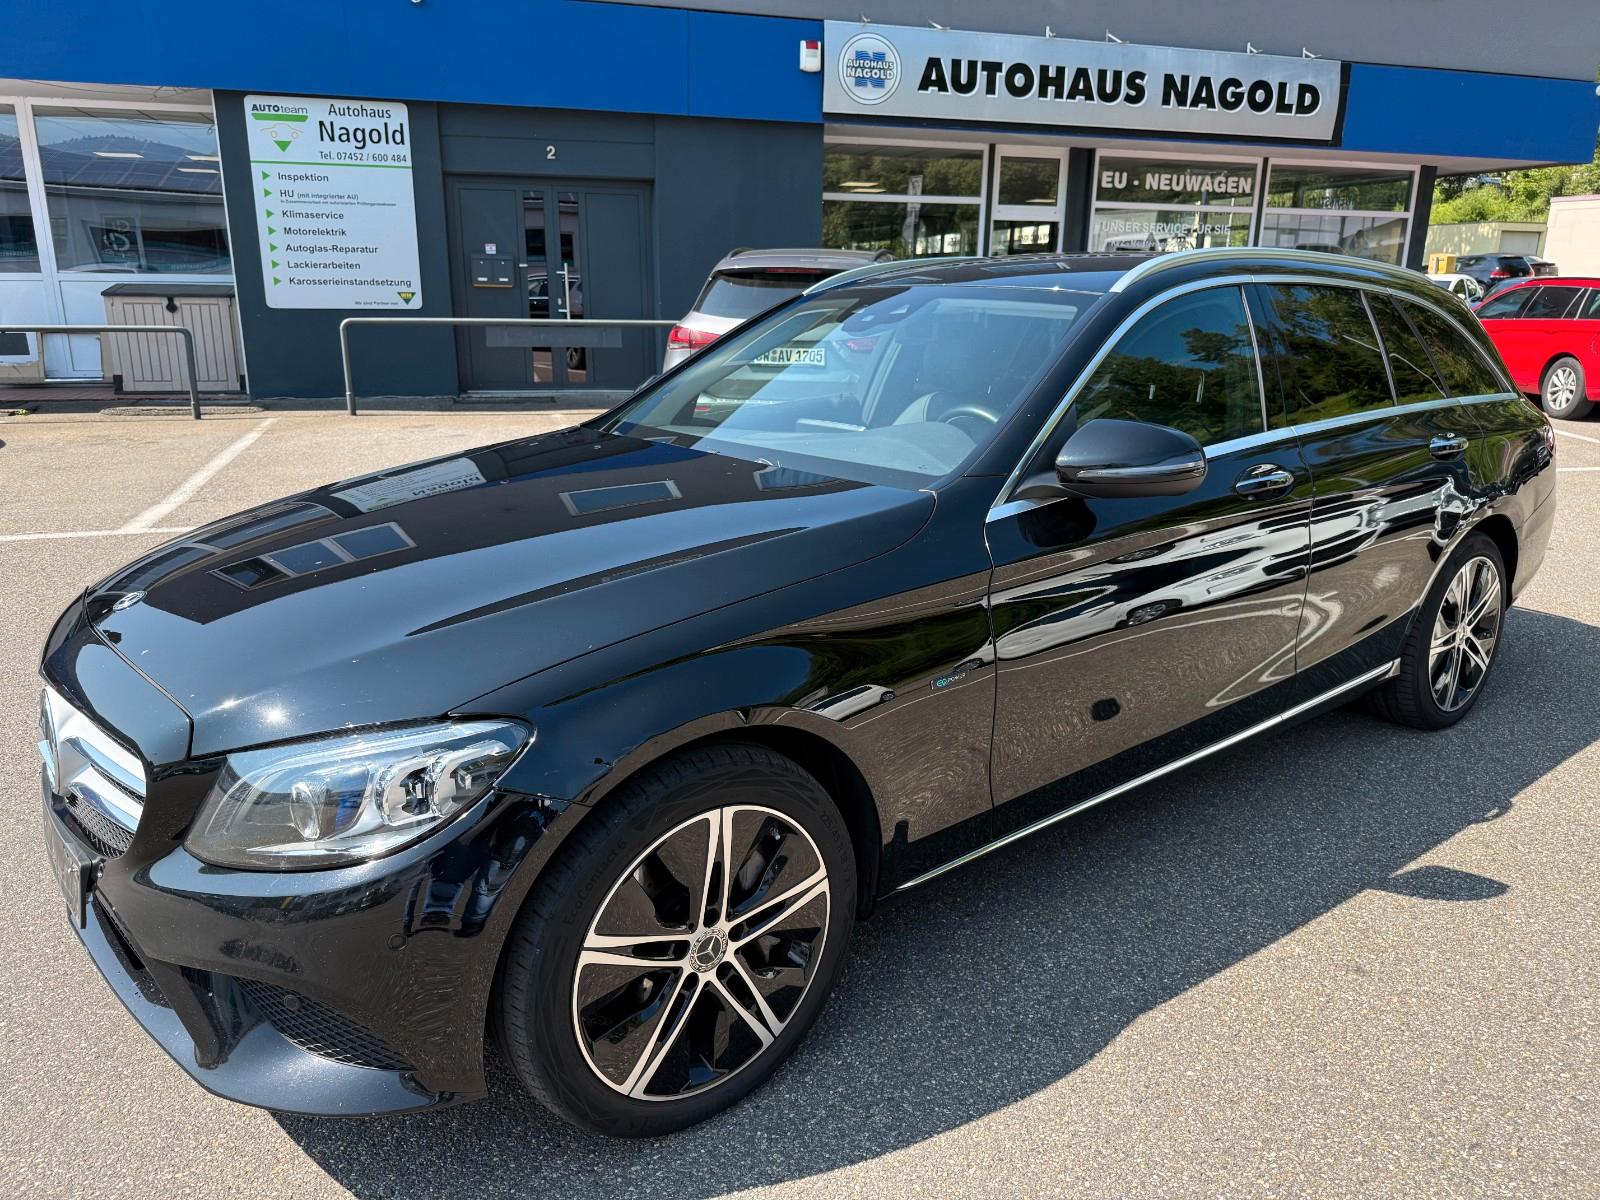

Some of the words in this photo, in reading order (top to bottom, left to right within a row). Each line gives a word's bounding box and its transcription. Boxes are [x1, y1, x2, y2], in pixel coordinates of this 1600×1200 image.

[846, 59, 895, 70] AUTOHAUS
[846, 67, 895, 80] NAGOLD
[917, 57, 1148, 106] AUTOHAUS
[1161, 73, 1322, 117] NAGOLD
[328, 103, 392, 119] Autohaus
[318, 120, 406, 150] Nagold
[319, 151, 335, 161] Tel.
[336, 152, 364, 161] 07452
[372, 153, 389, 162] 600
[391, 154, 407, 163] 484
[546, 145, 556, 160] 2
[278, 172, 329, 183] Inspektion
[1101, 171, 1128, 189] EU
[1145, 172, 1252, 194] NEUWAGEN
[279, 189, 295, 198] HU
[281, 210, 344, 220] Klimaservice
[283, 227, 347, 237] Motorelektrik
[1102, 221, 1141, 233] UNSER
[1142, 222, 1188, 235] SERVICE
[285, 244, 379, 255] Autoglas-Reparatur
[287, 261, 361, 271] Lackierarbeiten
[288, 277, 412, 289] Karosserieinstandsetzung
[778, 350, 792, 362] AV
[795, 350, 823, 362] 1705
